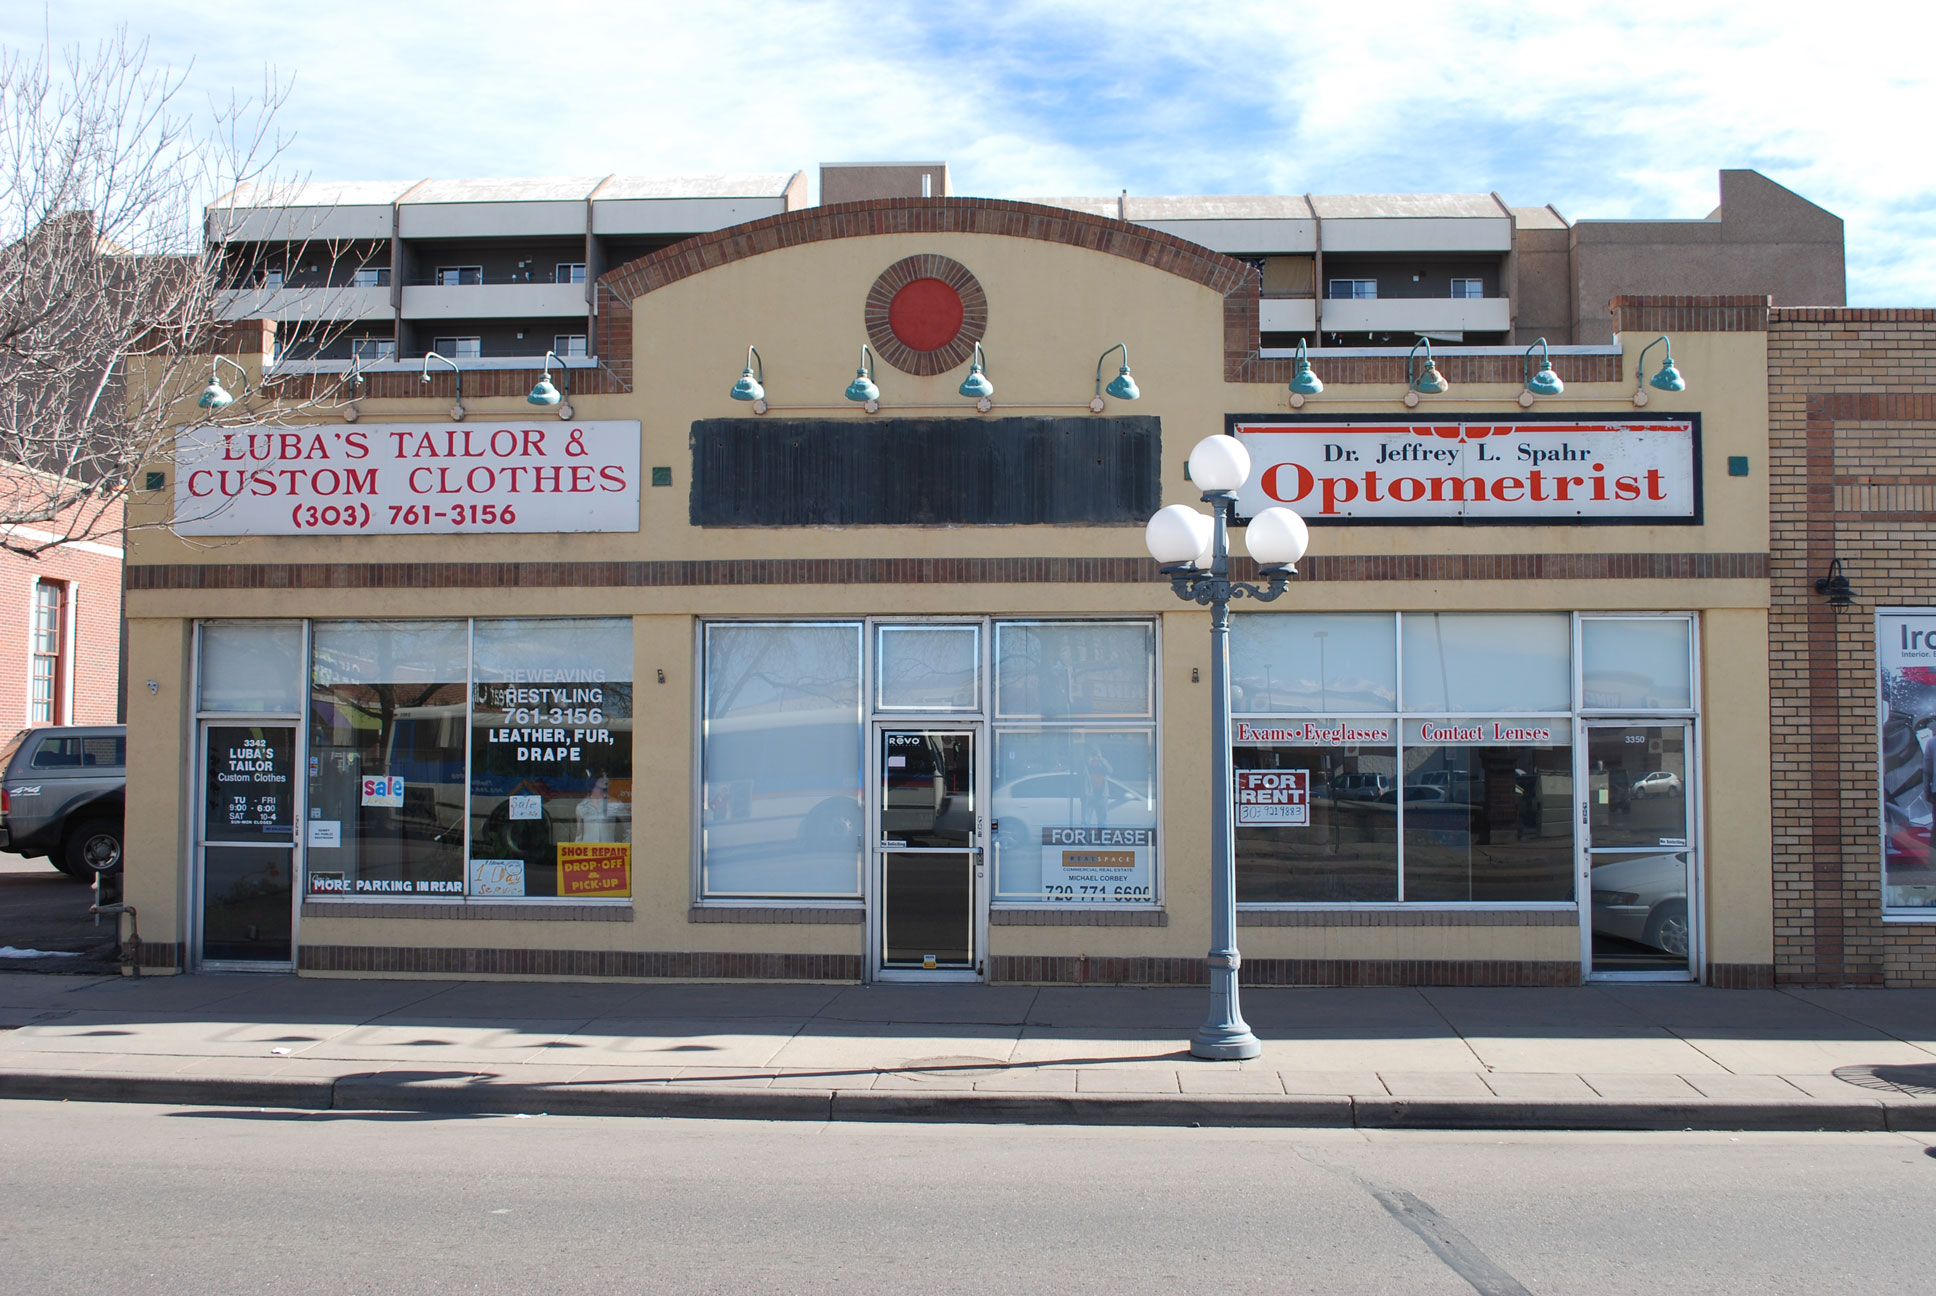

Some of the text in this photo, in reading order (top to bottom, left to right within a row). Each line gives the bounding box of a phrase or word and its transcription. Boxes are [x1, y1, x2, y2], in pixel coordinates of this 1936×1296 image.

[221, 428, 589, 461] LUBA'S TAILOR &
[1323, 442, 1591, 466] Dr. Jeffrey L. Spahr
[188, 464, 627, 498] CUSTOM CLOTHES
[1261, 462, 1668, 514] Optometrist
[292, 503, 516, 529] (303) 761-3156
[503, 668, 606, 683] REWEAVING
[505, 688, 604, 703] RESTYLING
[502, 707, 603, 725] 761-3156
[489, 728, 615, 746] LEATHER, FUR,
[1421, 722, 1550, 741] Contact Lenses
[244, 739, 266, 747] 3342
[230, 748, 274, 759] LUBA'S
[517, 747, 581, 761] DRAPE
[229, 760, 273, 771] TAILOR
[218, 772, 286, 782] Custom Clothes
[1248, 775, 1296, 788] FOR
[364, 776, 402, 796] sale
[234, 796, 246, 804] TU
[262, 796, 276, 804] FRI
[1241, 789, 1304, 803] RENT
[257, 804, 276, 812] 6:00
[229, 812, 245, 820] SAT
[1052, 829, 1146, 844] FOR LEASE
[561, 847, 628, 857] SHOE REPAIR
[314, 879, 351, 891] MORE
[356, 880, 412, 892] PARKING
[416, 881, 429, 892] IN
[430, 881, 463, 892] REAR
